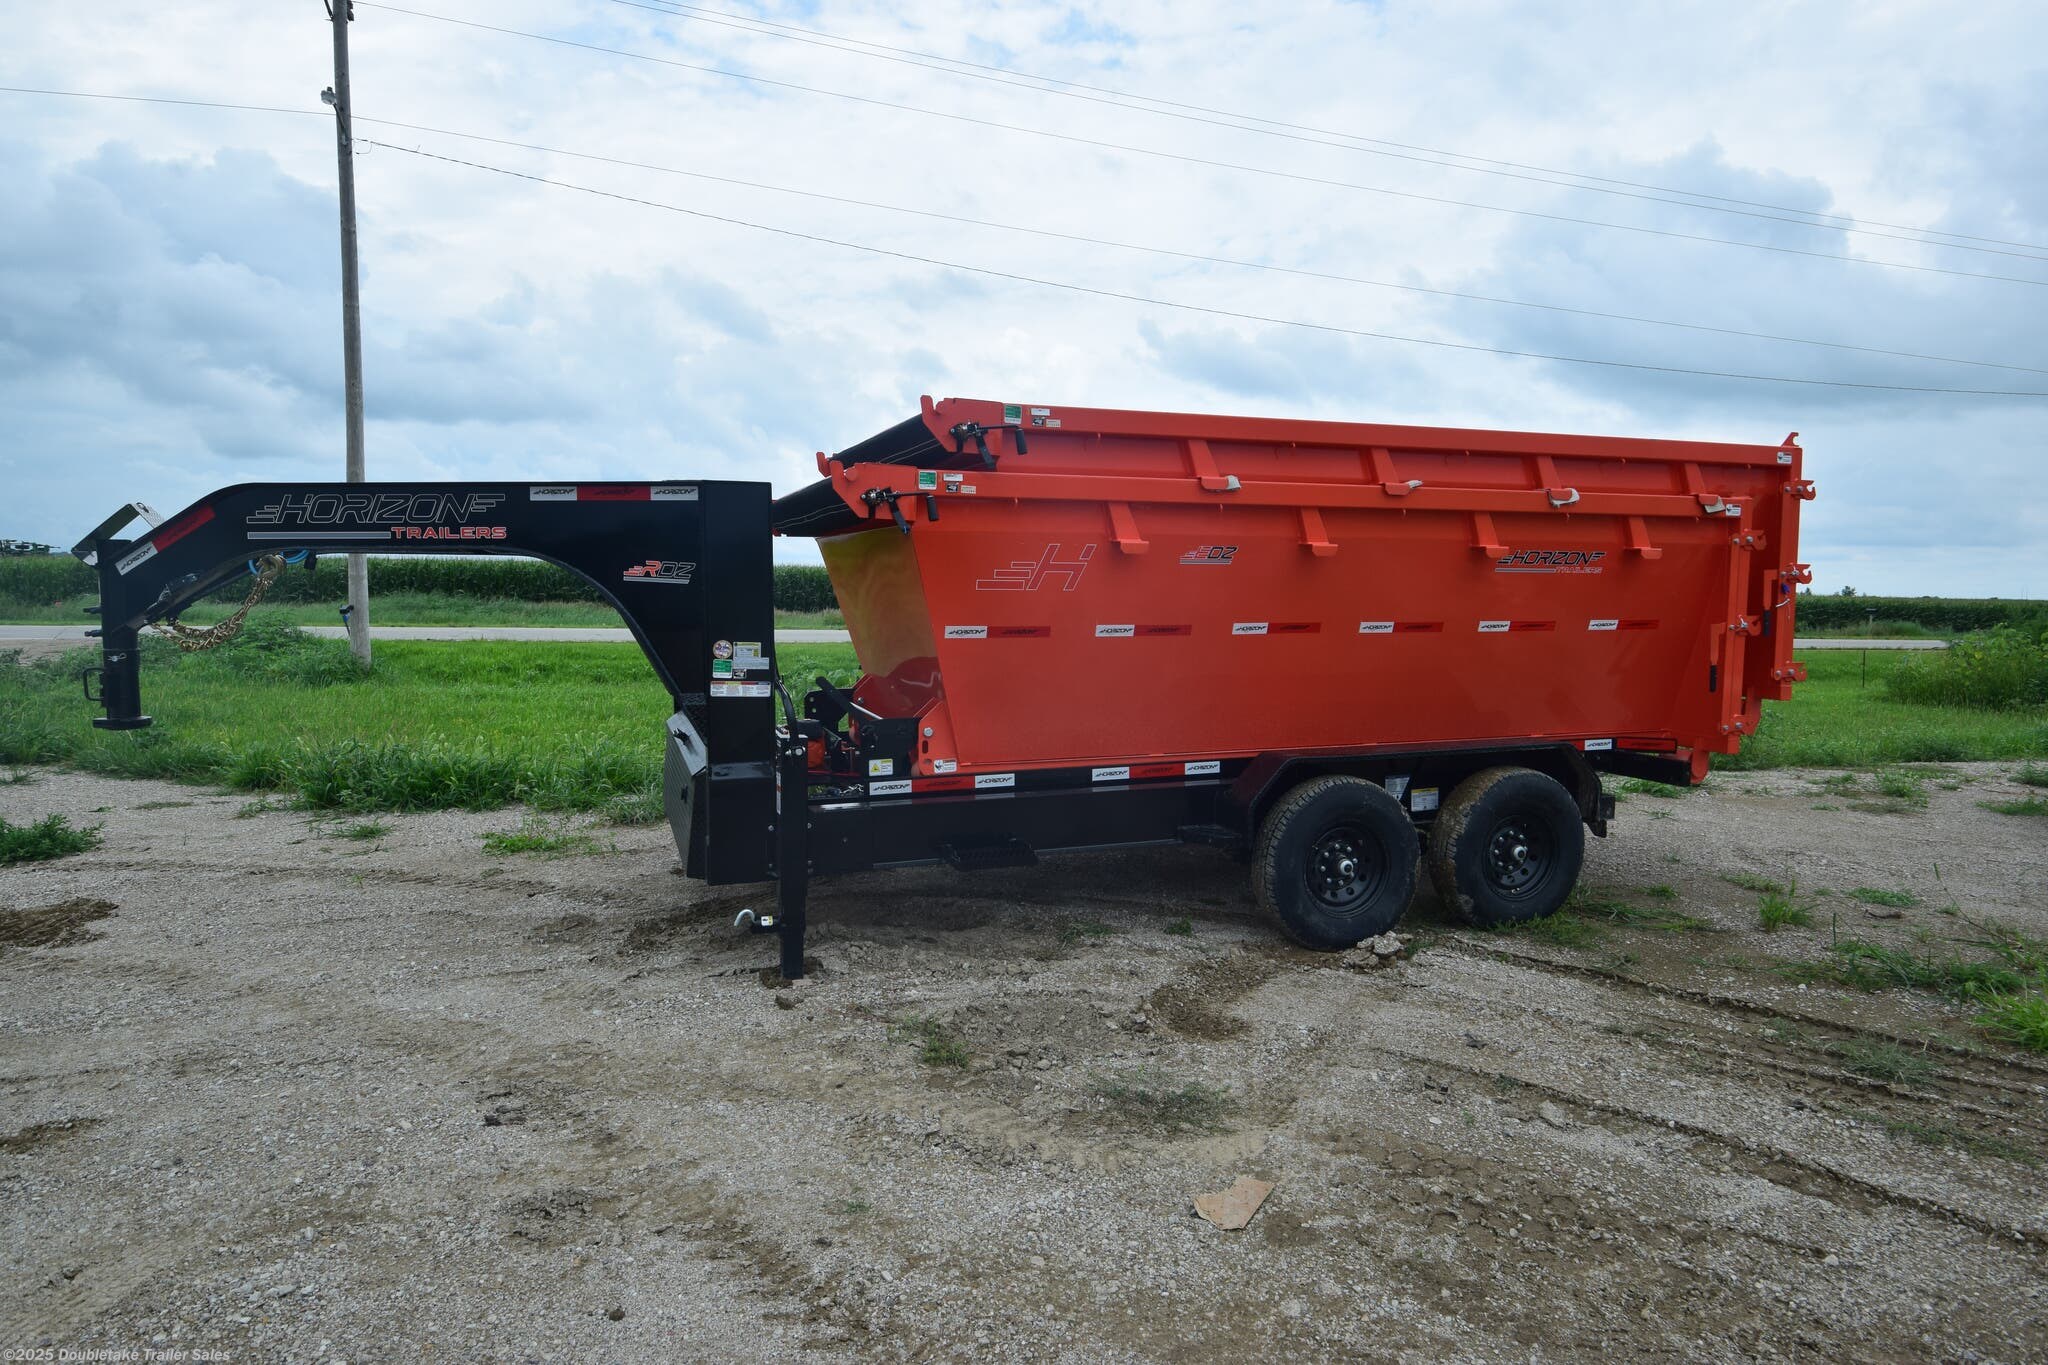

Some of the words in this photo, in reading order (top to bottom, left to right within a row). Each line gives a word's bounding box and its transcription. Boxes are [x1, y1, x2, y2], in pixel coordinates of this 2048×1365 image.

[246, 494, 505, 524] HORIZON
[391, 526, 507, 540] TRAILERS
[120, 546, 153, 571] HORIZON
[1497, 551, 1606, 565] HORIZON
[624, 560, 697, 579] RDZ
